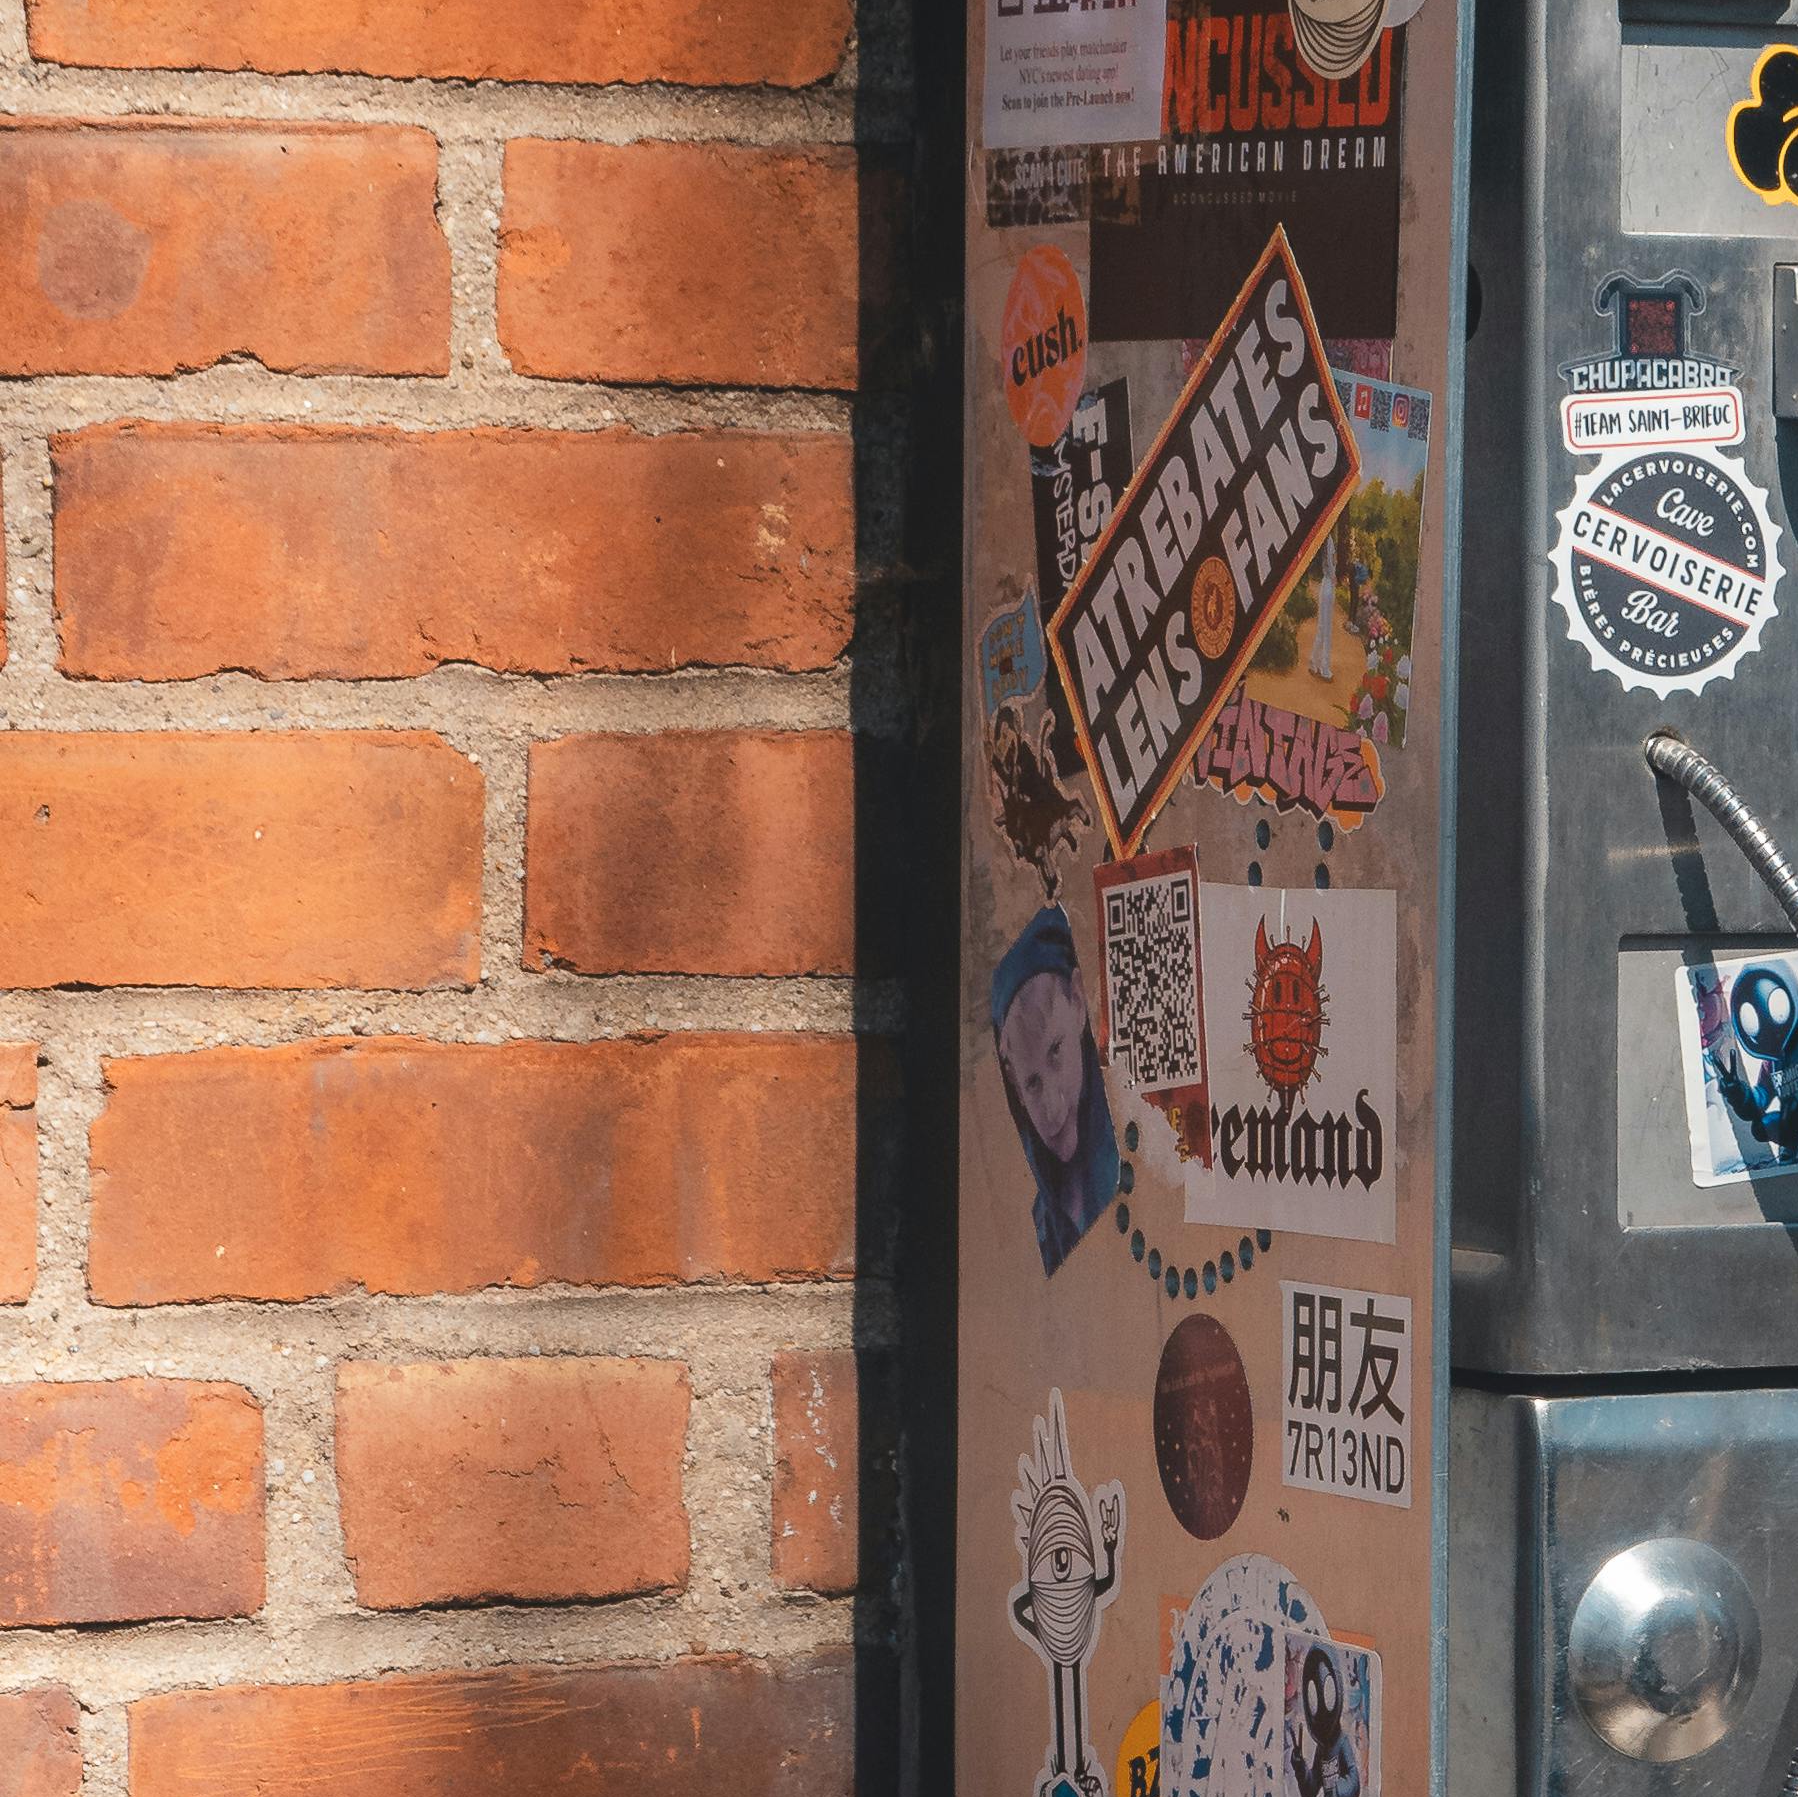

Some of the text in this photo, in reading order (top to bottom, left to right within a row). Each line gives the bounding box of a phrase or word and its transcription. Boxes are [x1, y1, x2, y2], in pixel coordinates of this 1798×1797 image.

[1102, 136, 1388, 178] THE AMERICAN DREAM
[1571, 358, 1734, 392] CHUPACABRA
[1072, 278, 1305, 720] ATREBATES
[1656, 487, 1715, 538] Cave
[1098, 610, 1203, 826] LENS
[1222, 382, 1339, 610] FANS
[1572, 510, 1764, 617] CERVOISERIE
[1620, 589, 1681, 639] Bar
[1579, 564, 1735, 669] BIÈRES PRÉCIEUSES
[1211, 1088, 1384, 1194] emand
[1287, 1291, 1406, 1427] 朋友
[1286, 1419, 1406, 1496] 7R13ND
